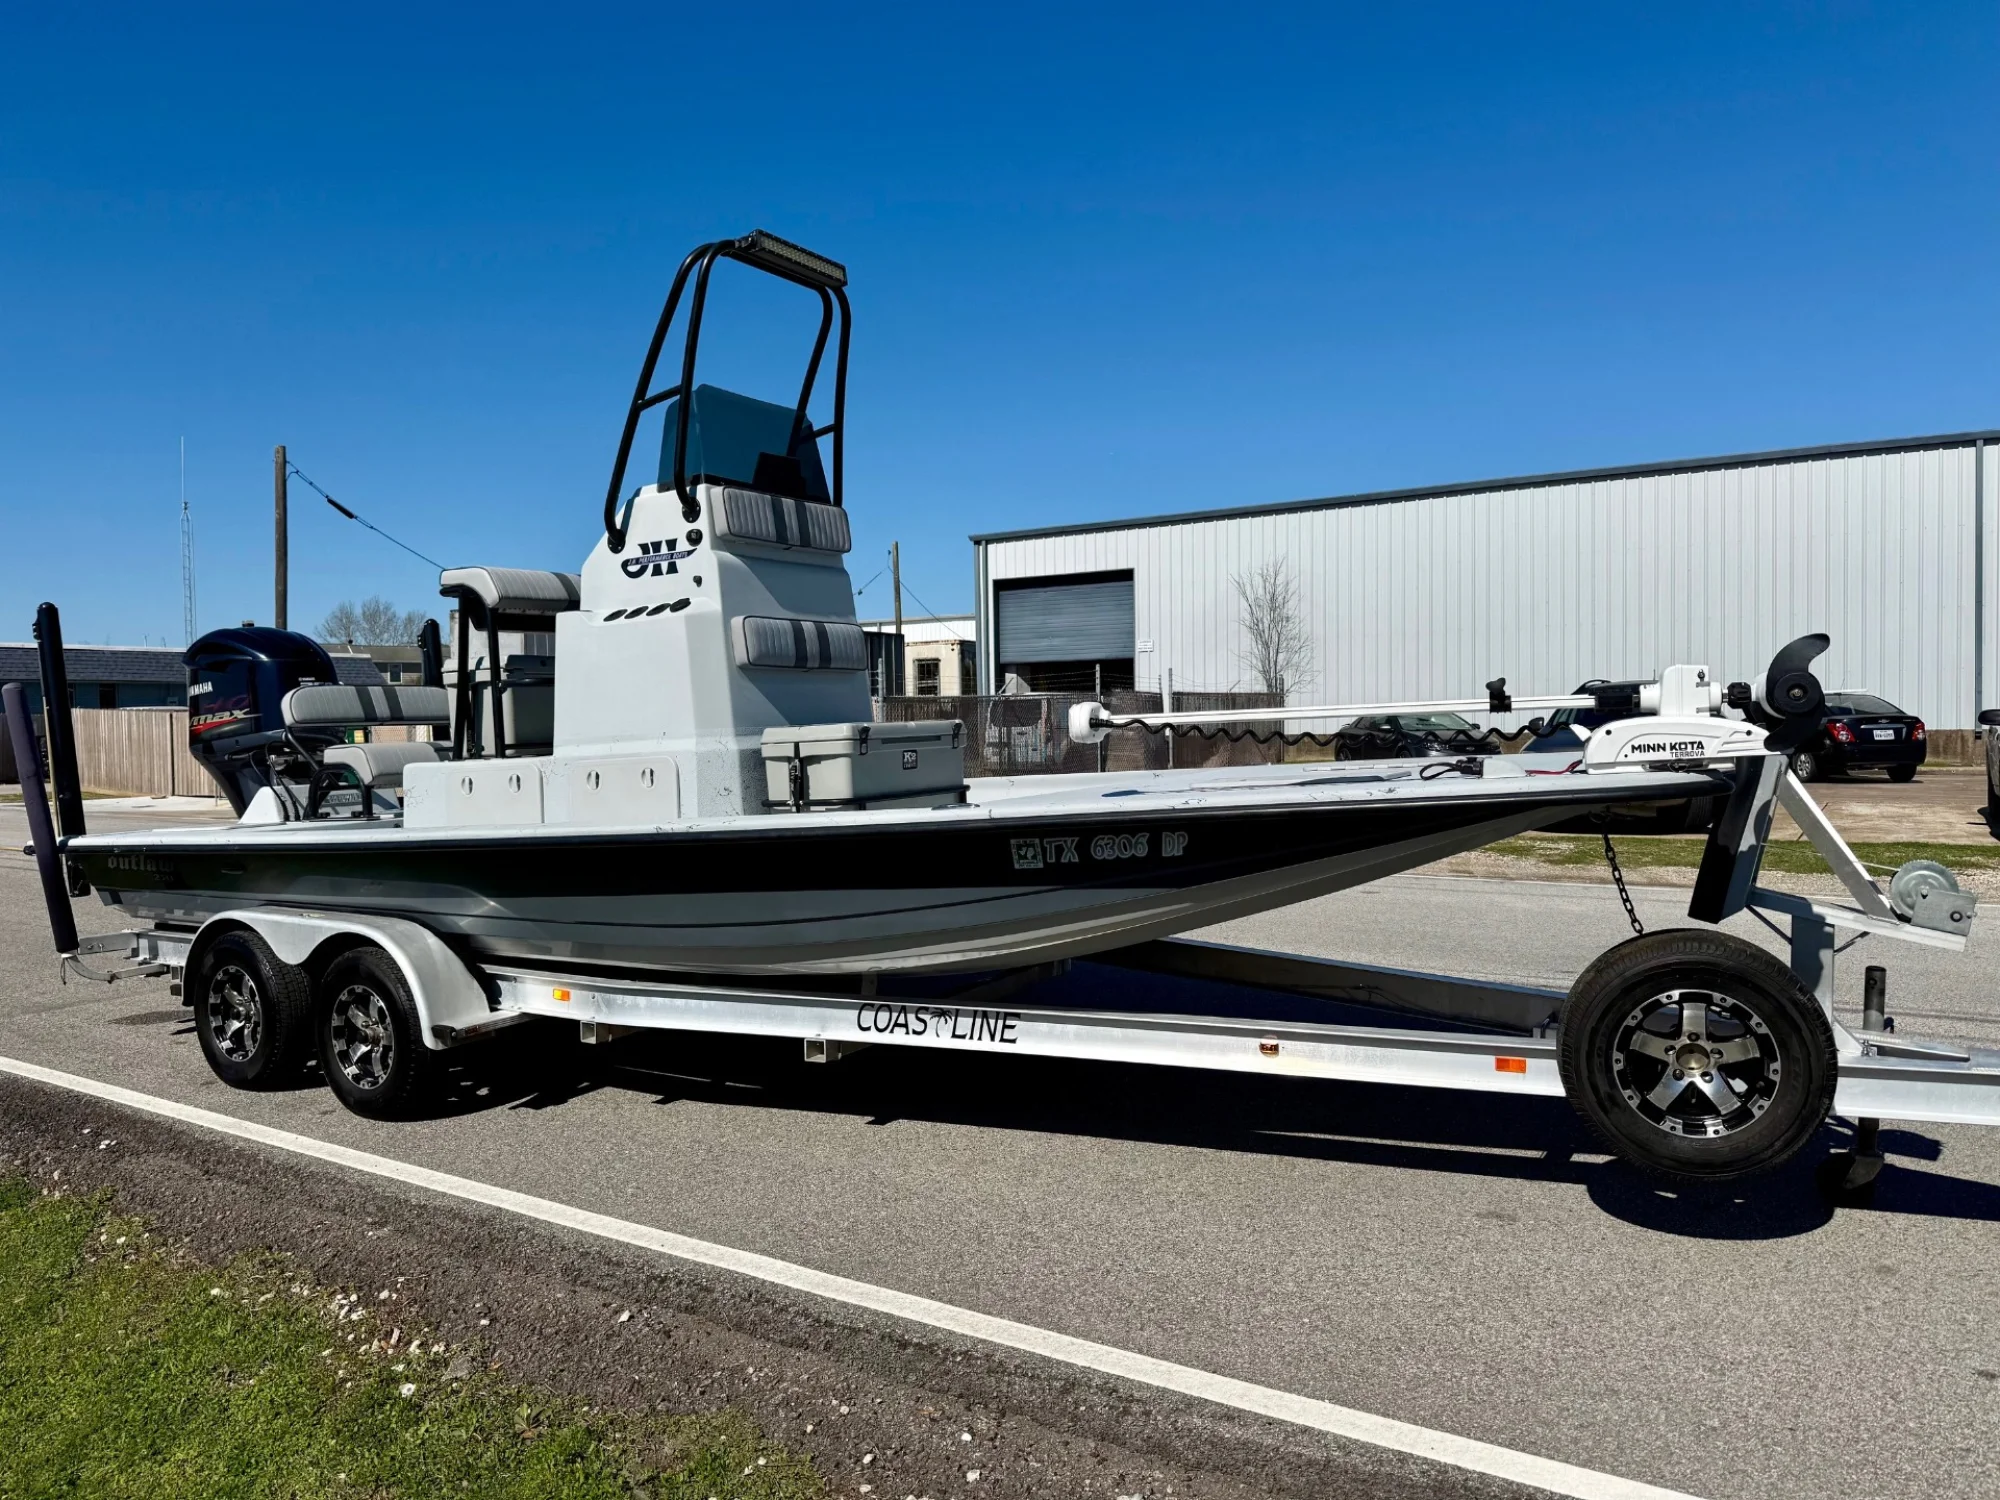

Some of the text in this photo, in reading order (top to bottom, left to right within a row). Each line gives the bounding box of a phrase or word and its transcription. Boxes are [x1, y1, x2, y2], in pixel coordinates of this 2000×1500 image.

[1631, 740, 1705, 754] MINN KOTA
[1670, 750, 1705, 758] TERROVA
[1044, 837, 1080, 863] TX
[1091, 833, 1150, 860] 6306
[1162, 832, 1188, 857] DP
